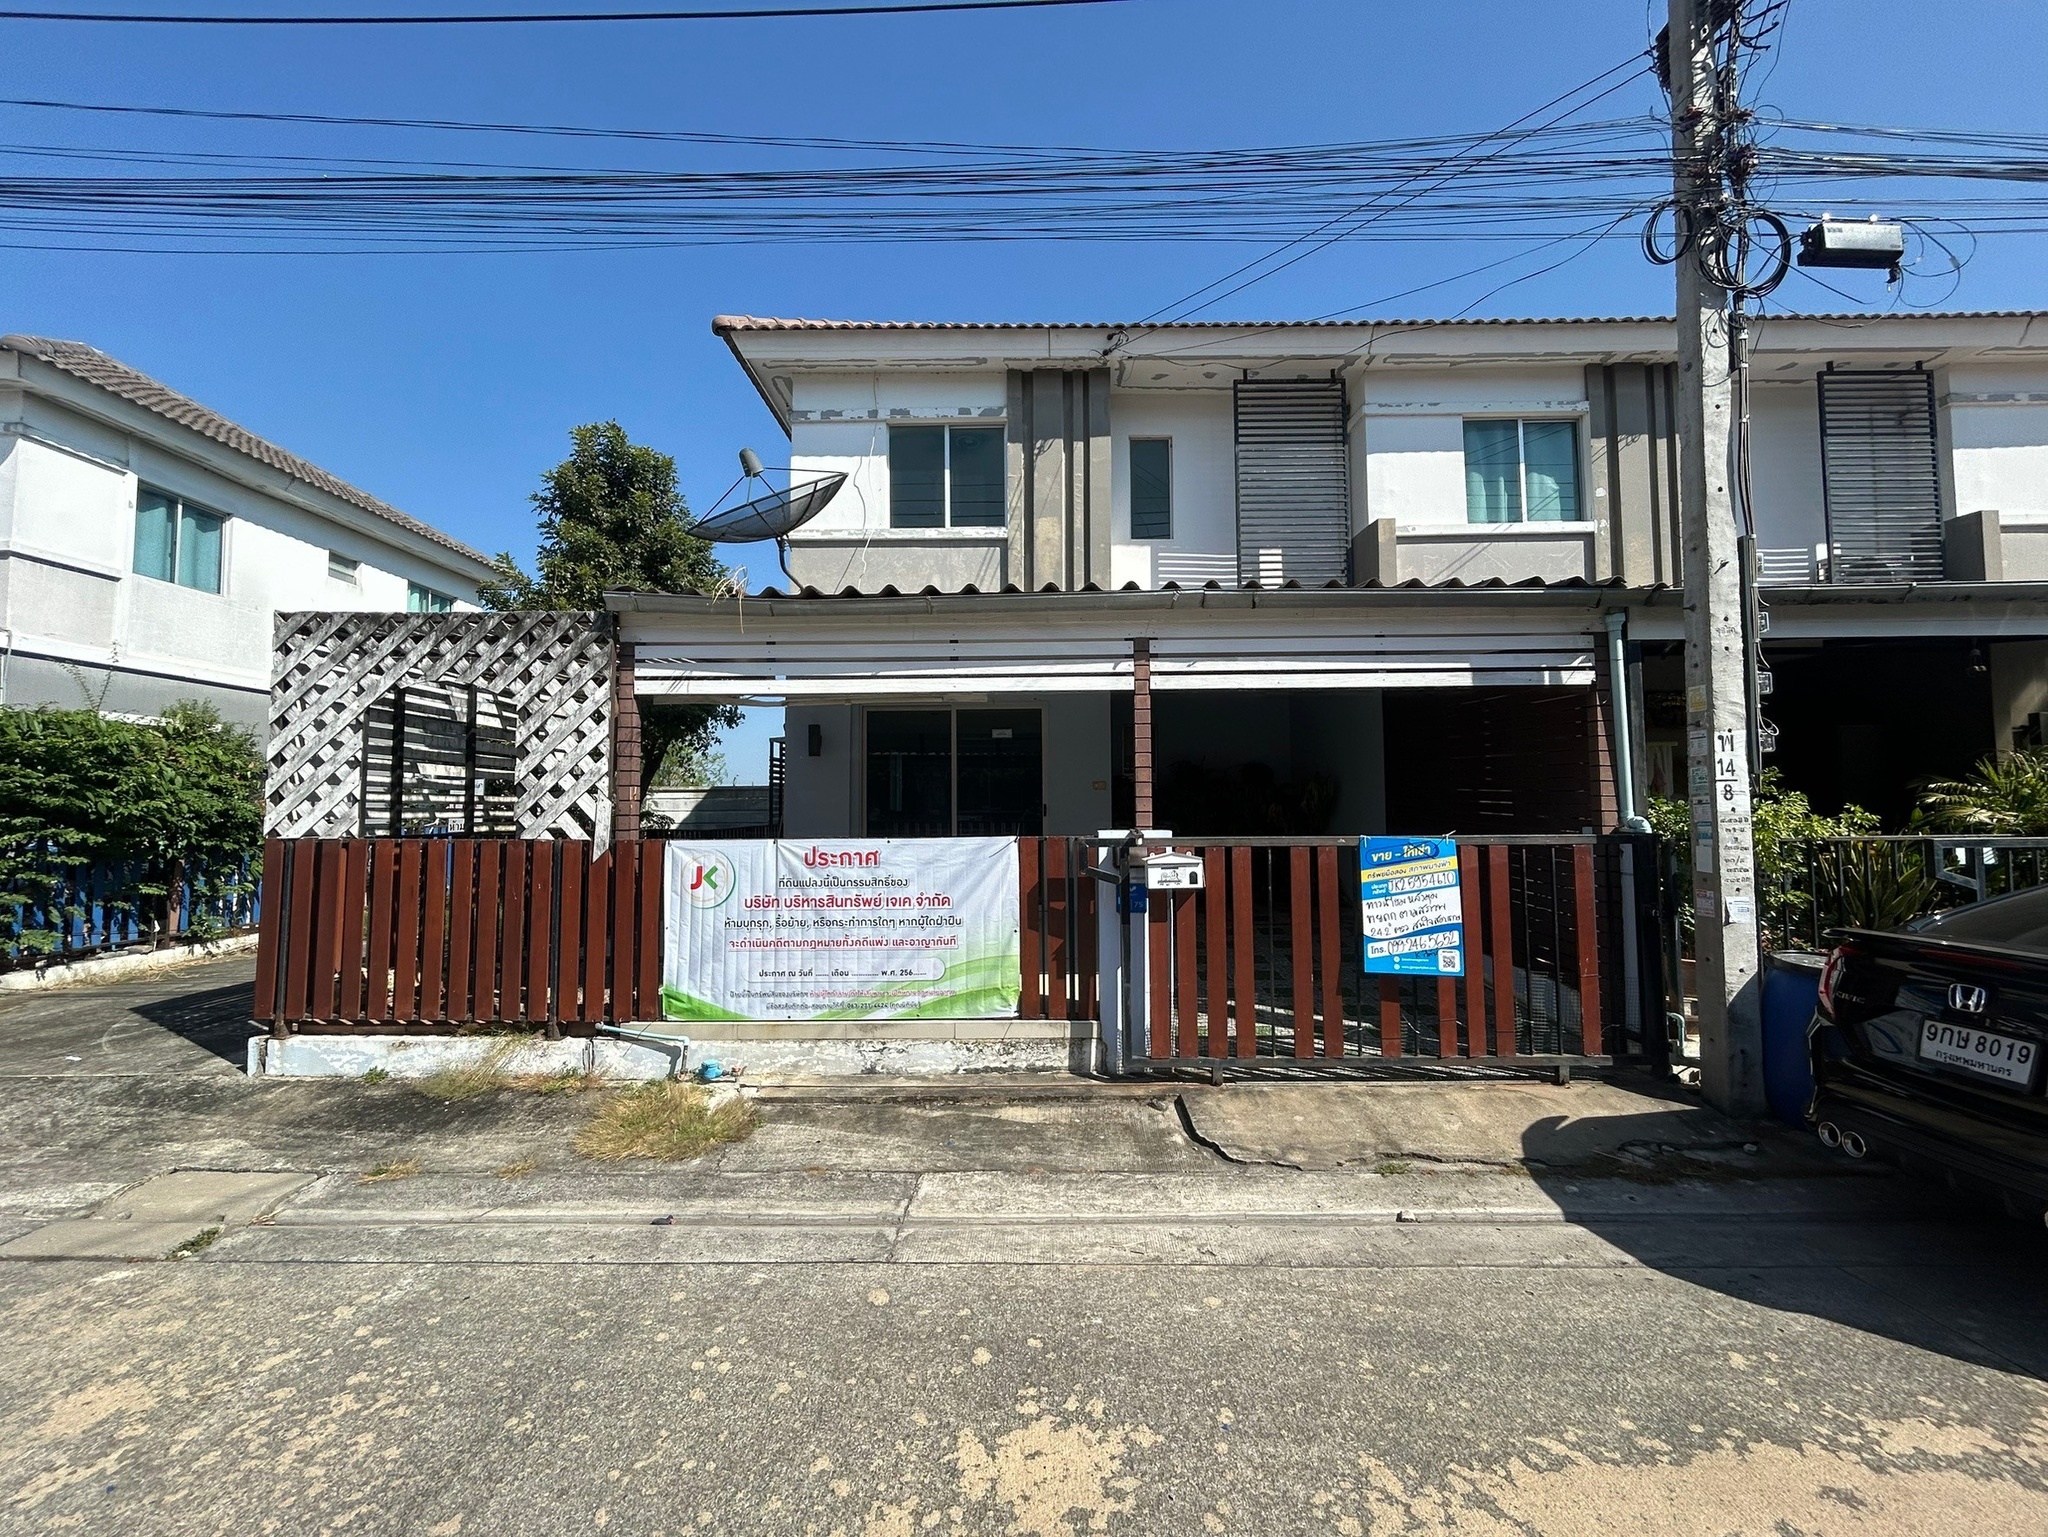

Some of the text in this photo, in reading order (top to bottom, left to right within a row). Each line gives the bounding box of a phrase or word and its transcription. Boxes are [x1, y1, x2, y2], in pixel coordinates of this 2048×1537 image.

[1716, 758, 1736, 776] 14
[1723, 784, 1734, 801] 8
[804, 846, 879, 867] ประกาศ
[1371, 851, 1393, 863] ขาย
[690, 865, 719, 890] JK
[778, 874, 908, 888] ที่ดินแปลงนี้เป็นกรรมสิทธิ์ของ
[744, 892, 951, 909] บริษัท บริหารสินทรัพย์ เจเค จำกัด
[724, 917, 772, 931] ห้ามบุกรุก,
[898, 915, 962, 930] หากผู้ใดฝ่าฝืน
[892, 935, 957, 949] และอาญาทันที
[758, 969, 786, 978] ประกาศ
[1974, 1035, 2032, 1065] 8019
[1936, 1049, 2013, 1077] กรุงเทพมหานคร
